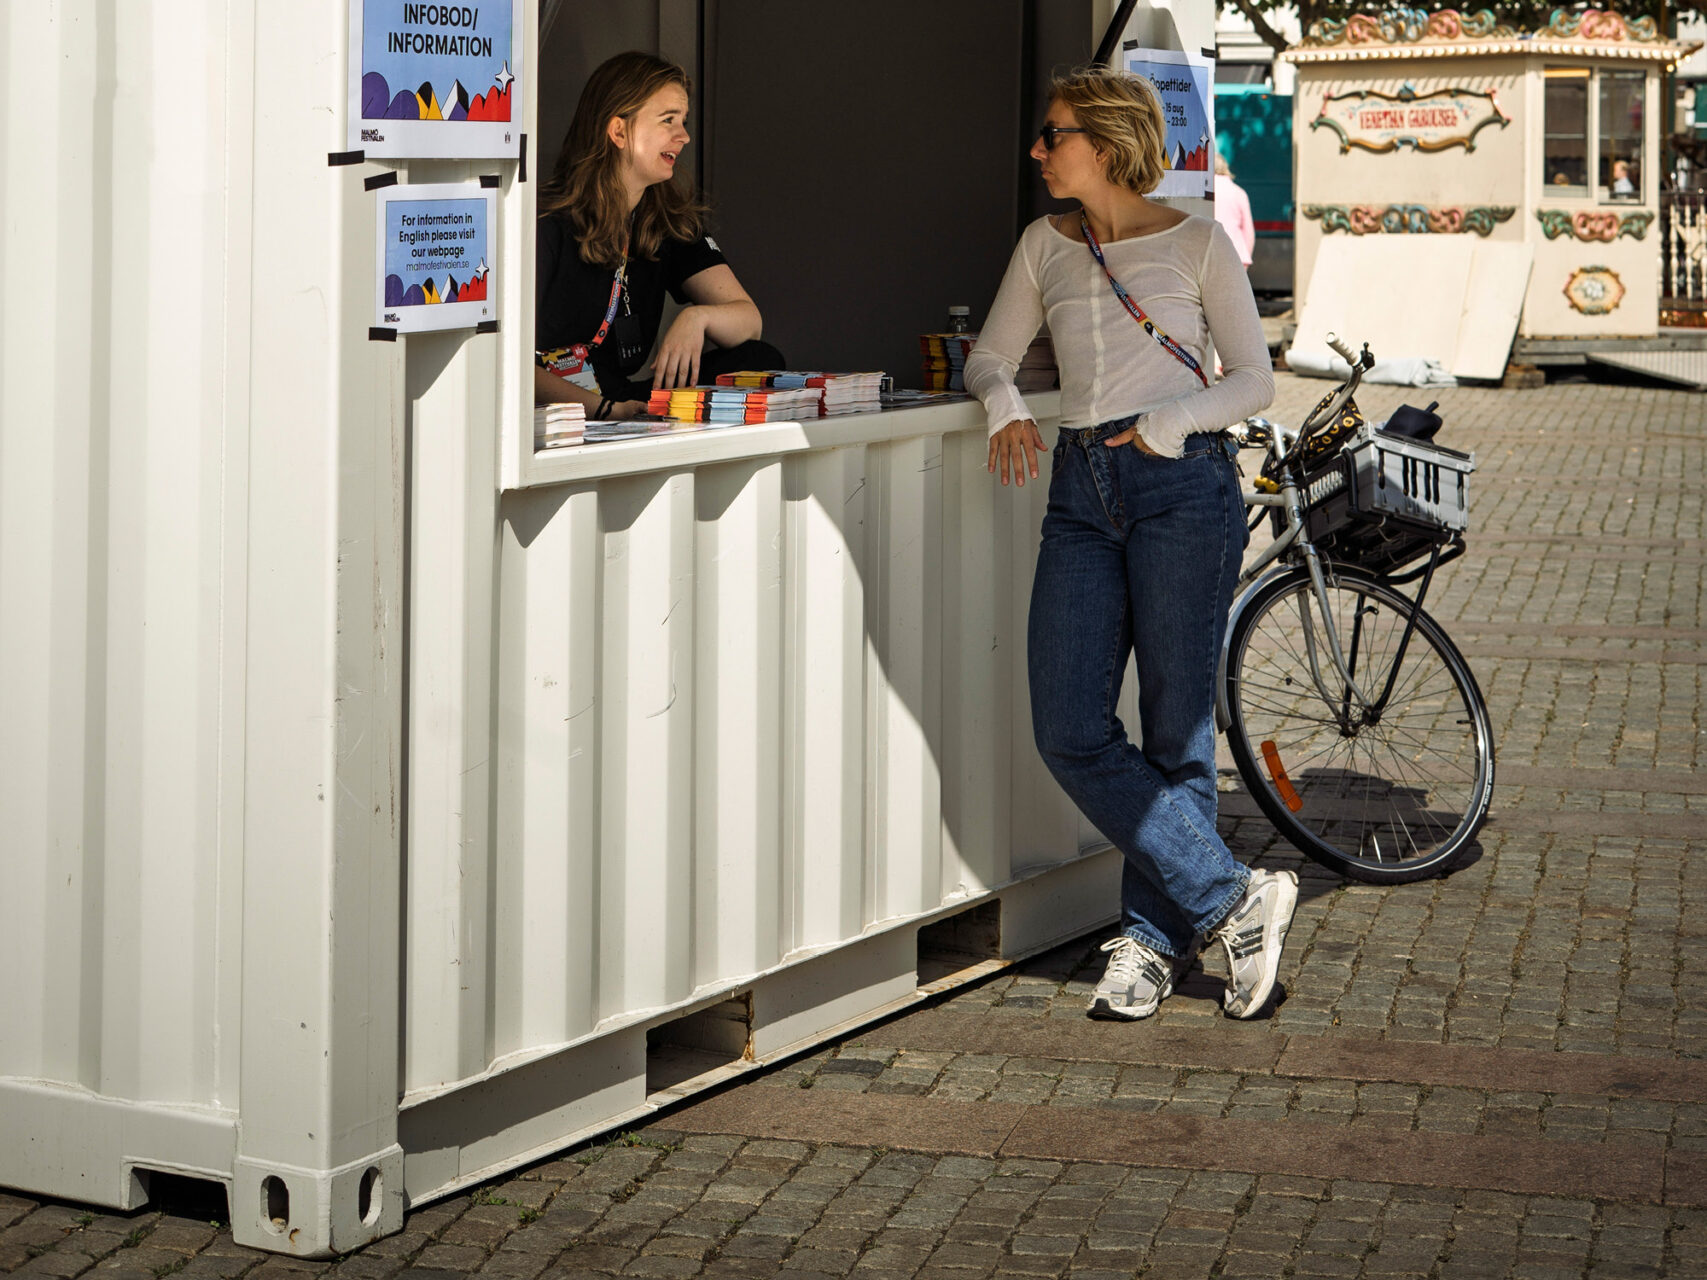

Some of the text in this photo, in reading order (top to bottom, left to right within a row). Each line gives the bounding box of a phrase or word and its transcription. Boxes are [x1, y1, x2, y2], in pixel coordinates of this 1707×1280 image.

[403, 2, 479, 31] INFOBOD/
[387, 31, 493, 58] INFORMATION
[1172, 105, 1184, 116] aug
[1171, 116, 1187, 127] 23:00
[401, 213, 473, 227] For information in
[399, 228, 476, 246] English please visit
[411, 245, 465, 259] our webpage
[405, 260, 470, 272] malmofestivalen.se
